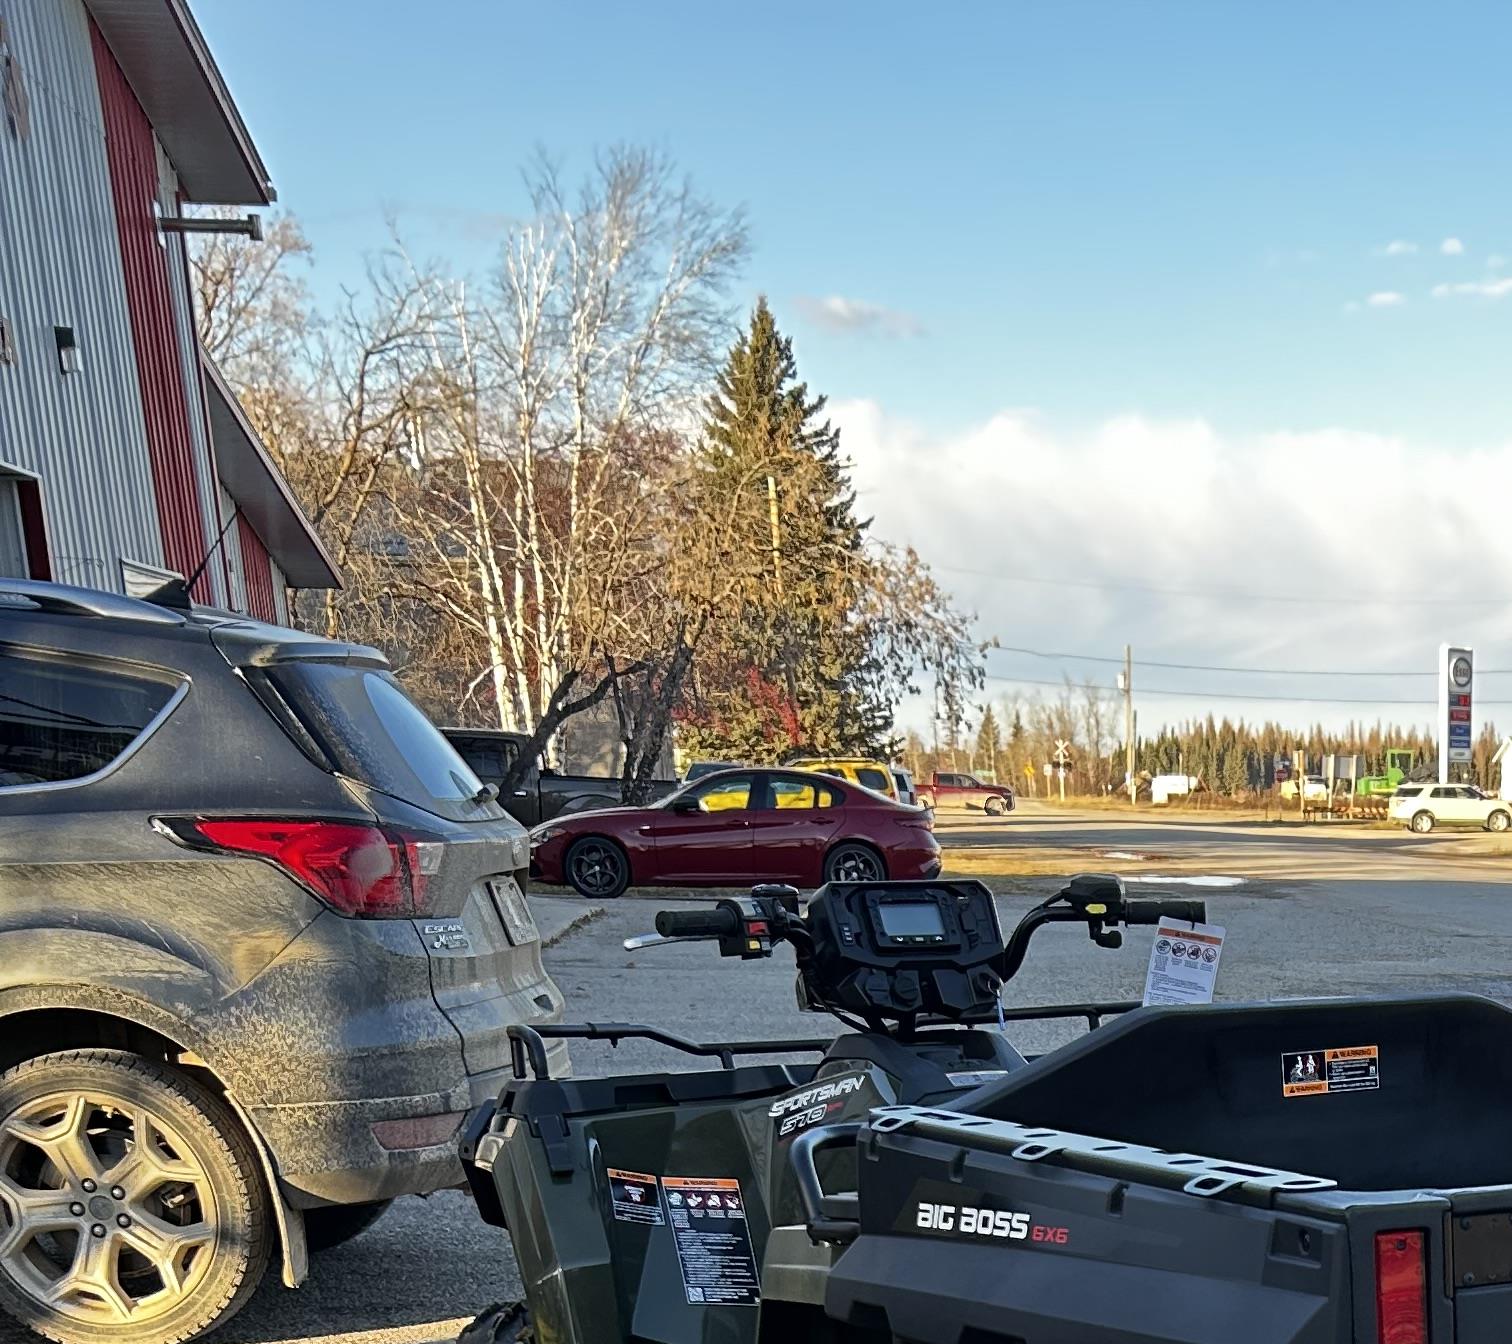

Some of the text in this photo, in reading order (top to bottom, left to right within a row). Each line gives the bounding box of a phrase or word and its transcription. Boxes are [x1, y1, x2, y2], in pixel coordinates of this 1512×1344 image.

[768, 1075, 865, 1117] SPORTSMAN
[779, 1103, 828, 1136] 570
[916, 1202, 1069, 1244] BIG BOSS 6X6
